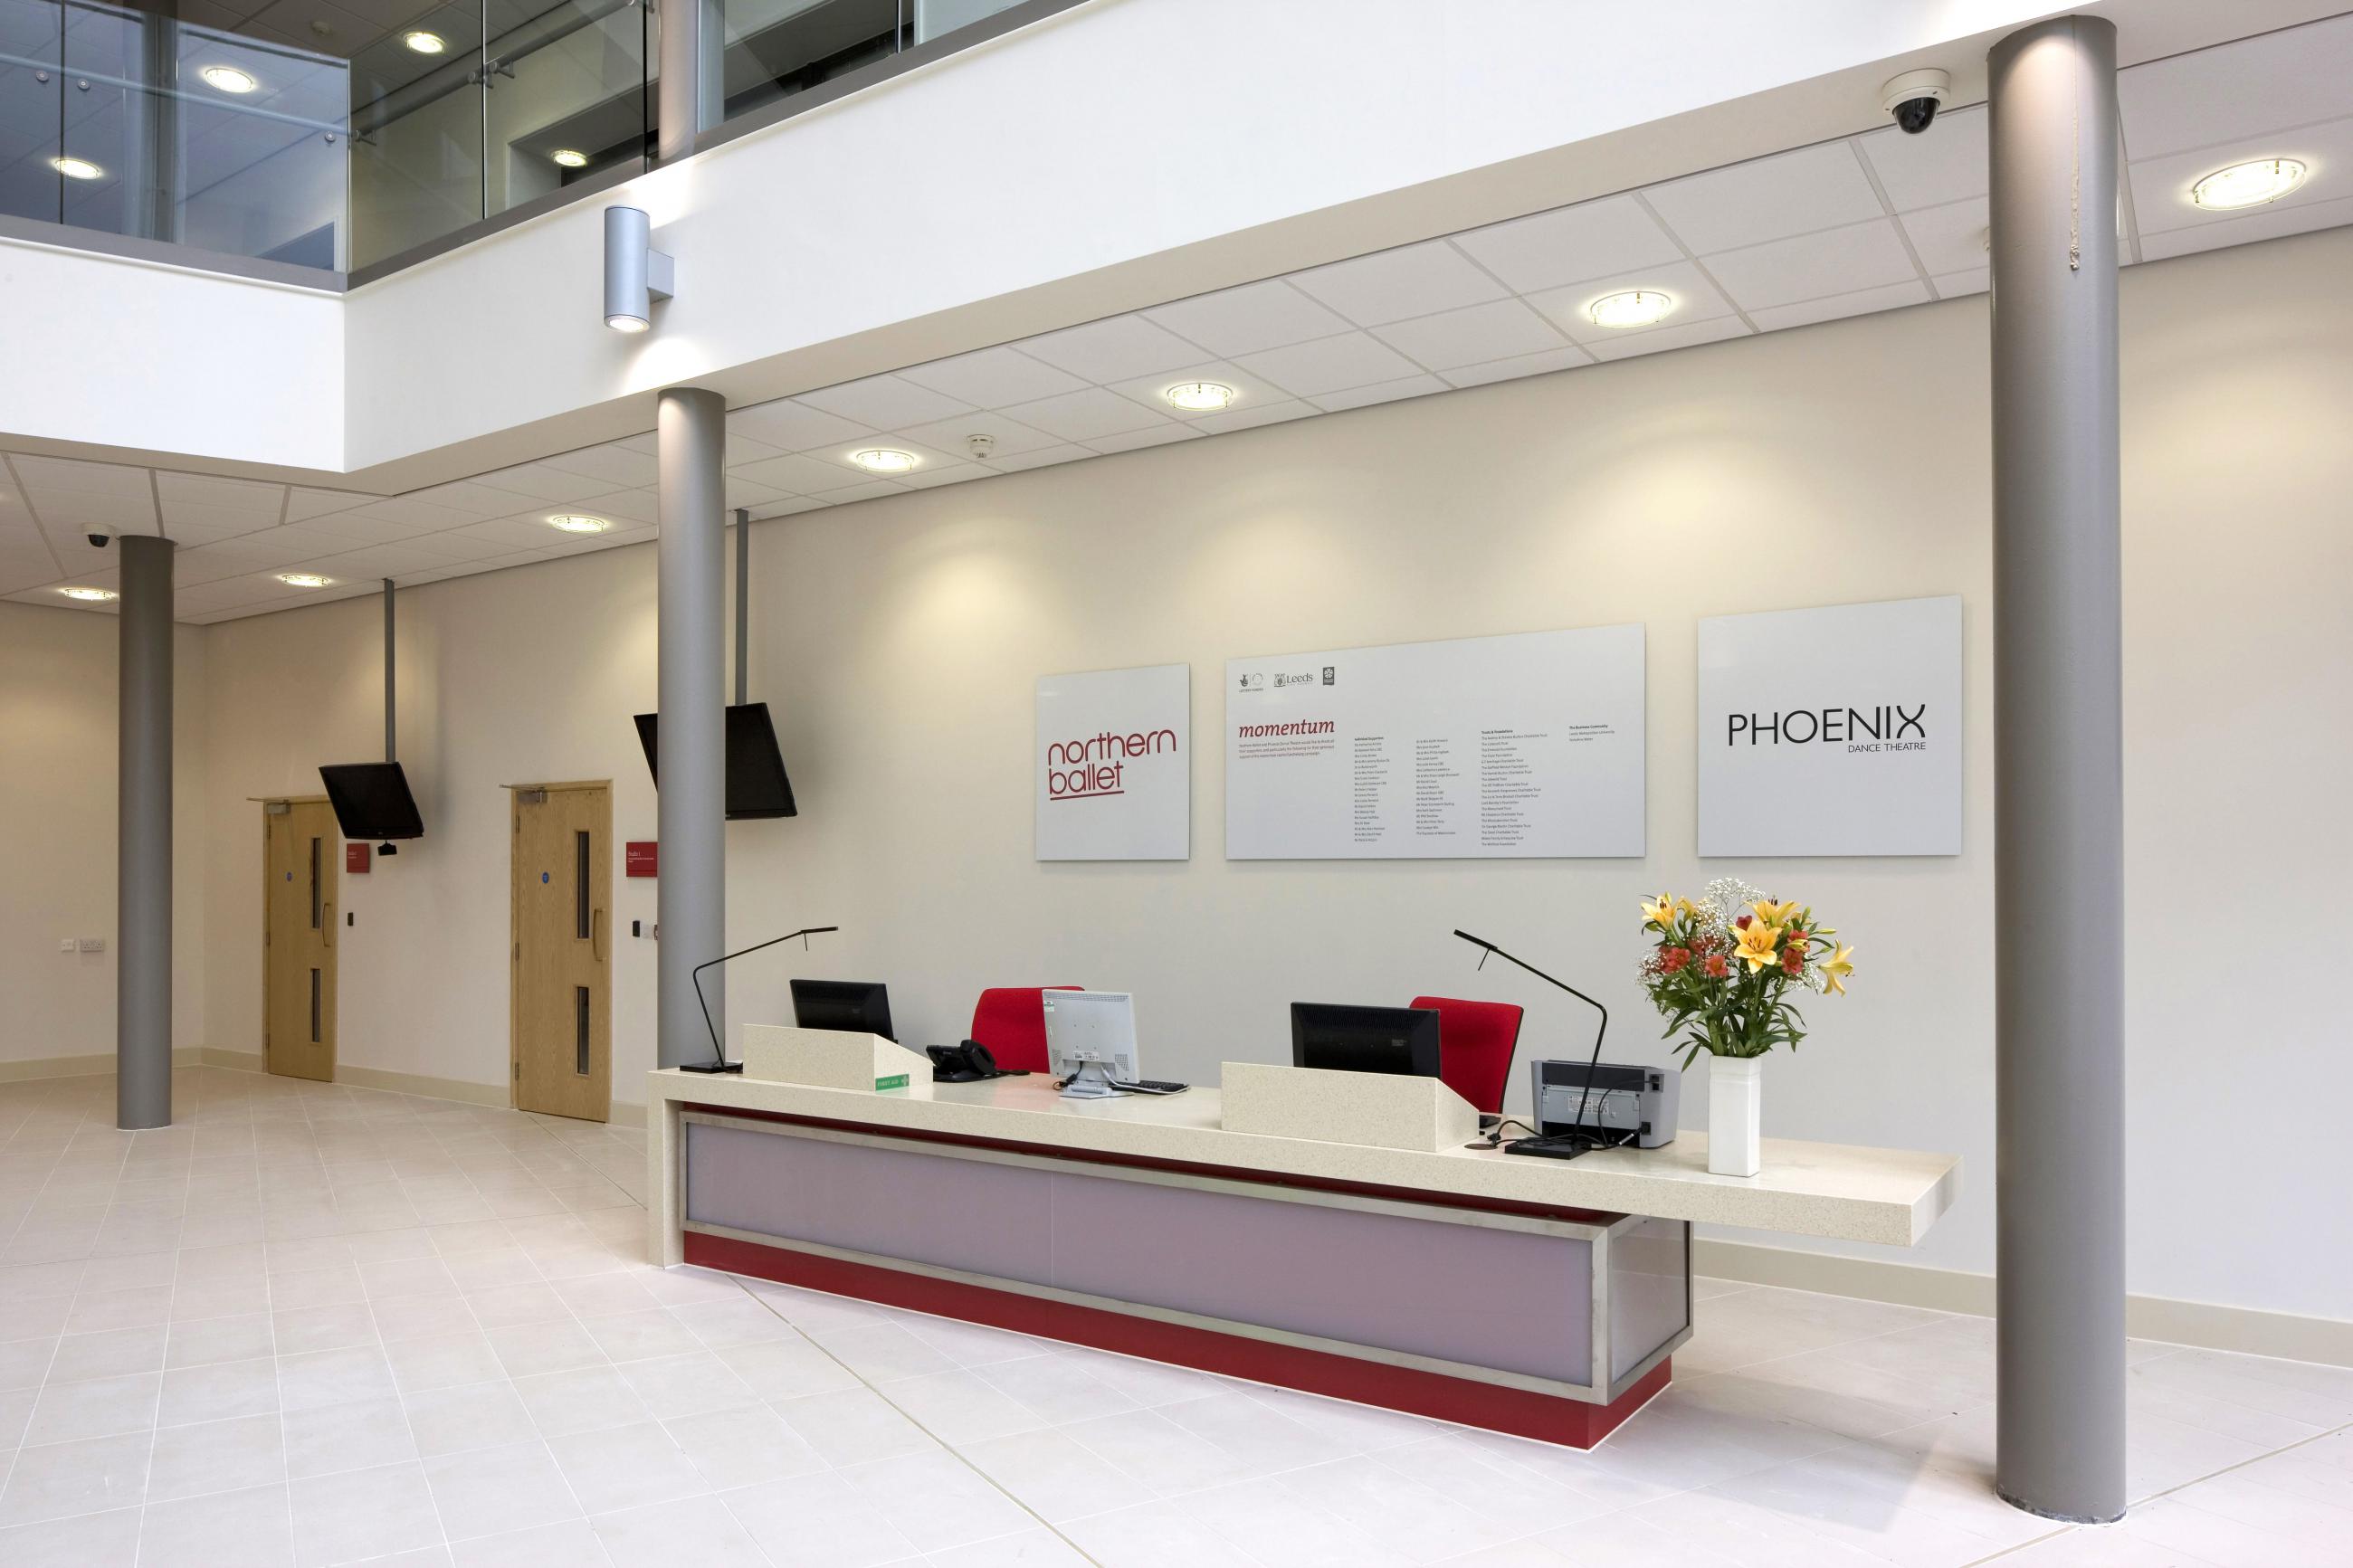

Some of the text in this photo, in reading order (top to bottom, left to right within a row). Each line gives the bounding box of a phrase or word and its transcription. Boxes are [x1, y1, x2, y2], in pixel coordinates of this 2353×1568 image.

[1287, 673, 1313, 684] Leeds
[1239, 719, 1335, 737] momentum
[1729, 704, 1926, 746] PHOENIX
[1048, 729, 1176, 766] northern
[1848, 742, 1926, 753] DANCE THEATRE
[1049, 761, 1124, 794] ballet
